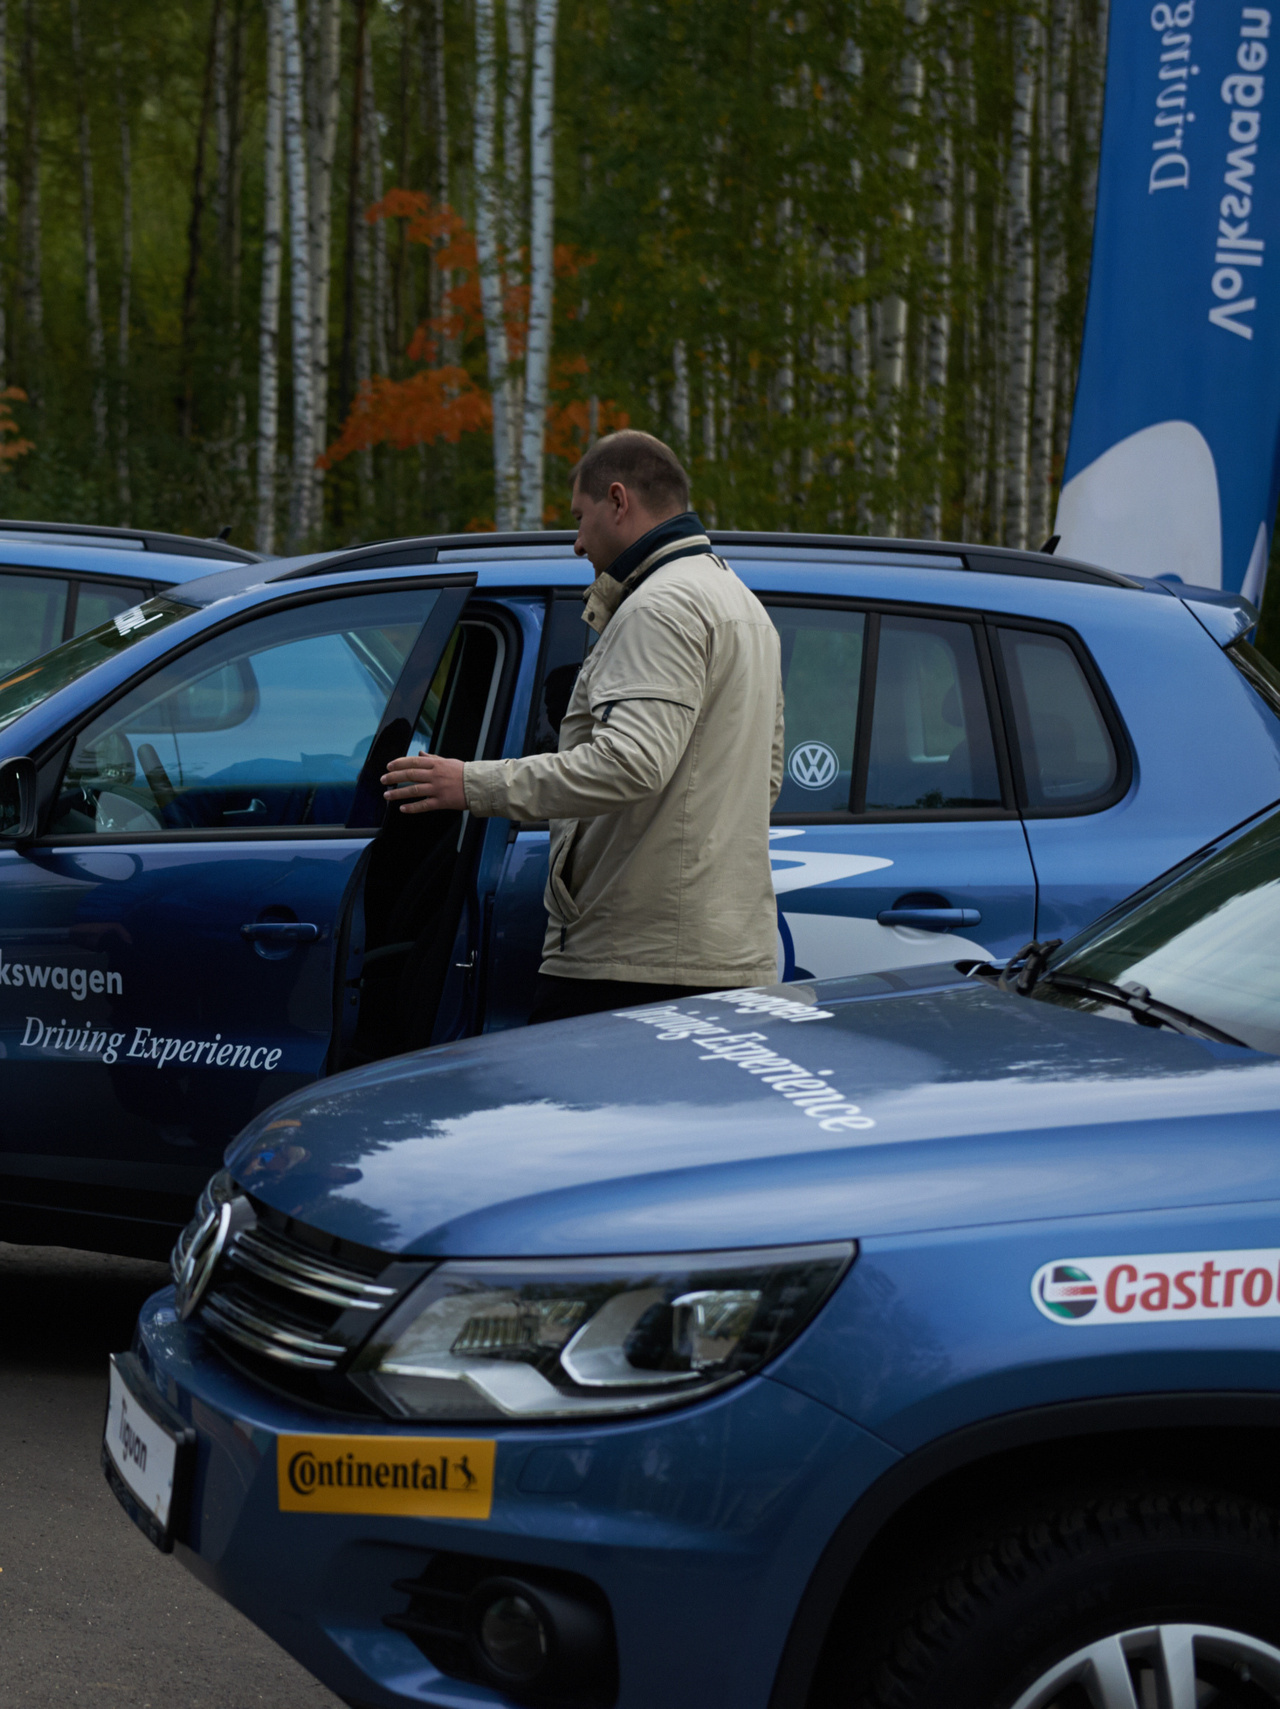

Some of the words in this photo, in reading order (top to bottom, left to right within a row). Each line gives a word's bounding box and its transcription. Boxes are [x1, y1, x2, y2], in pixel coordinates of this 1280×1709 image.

[20, 1016, 126, 1064] Driving
[126, 1026, 282, 1071] Experience
[692, 1031, 876, 1132] Experience
[1104, 1259, 1280, 1314] Castro
[288, 1450, 448, 1495] Continental
